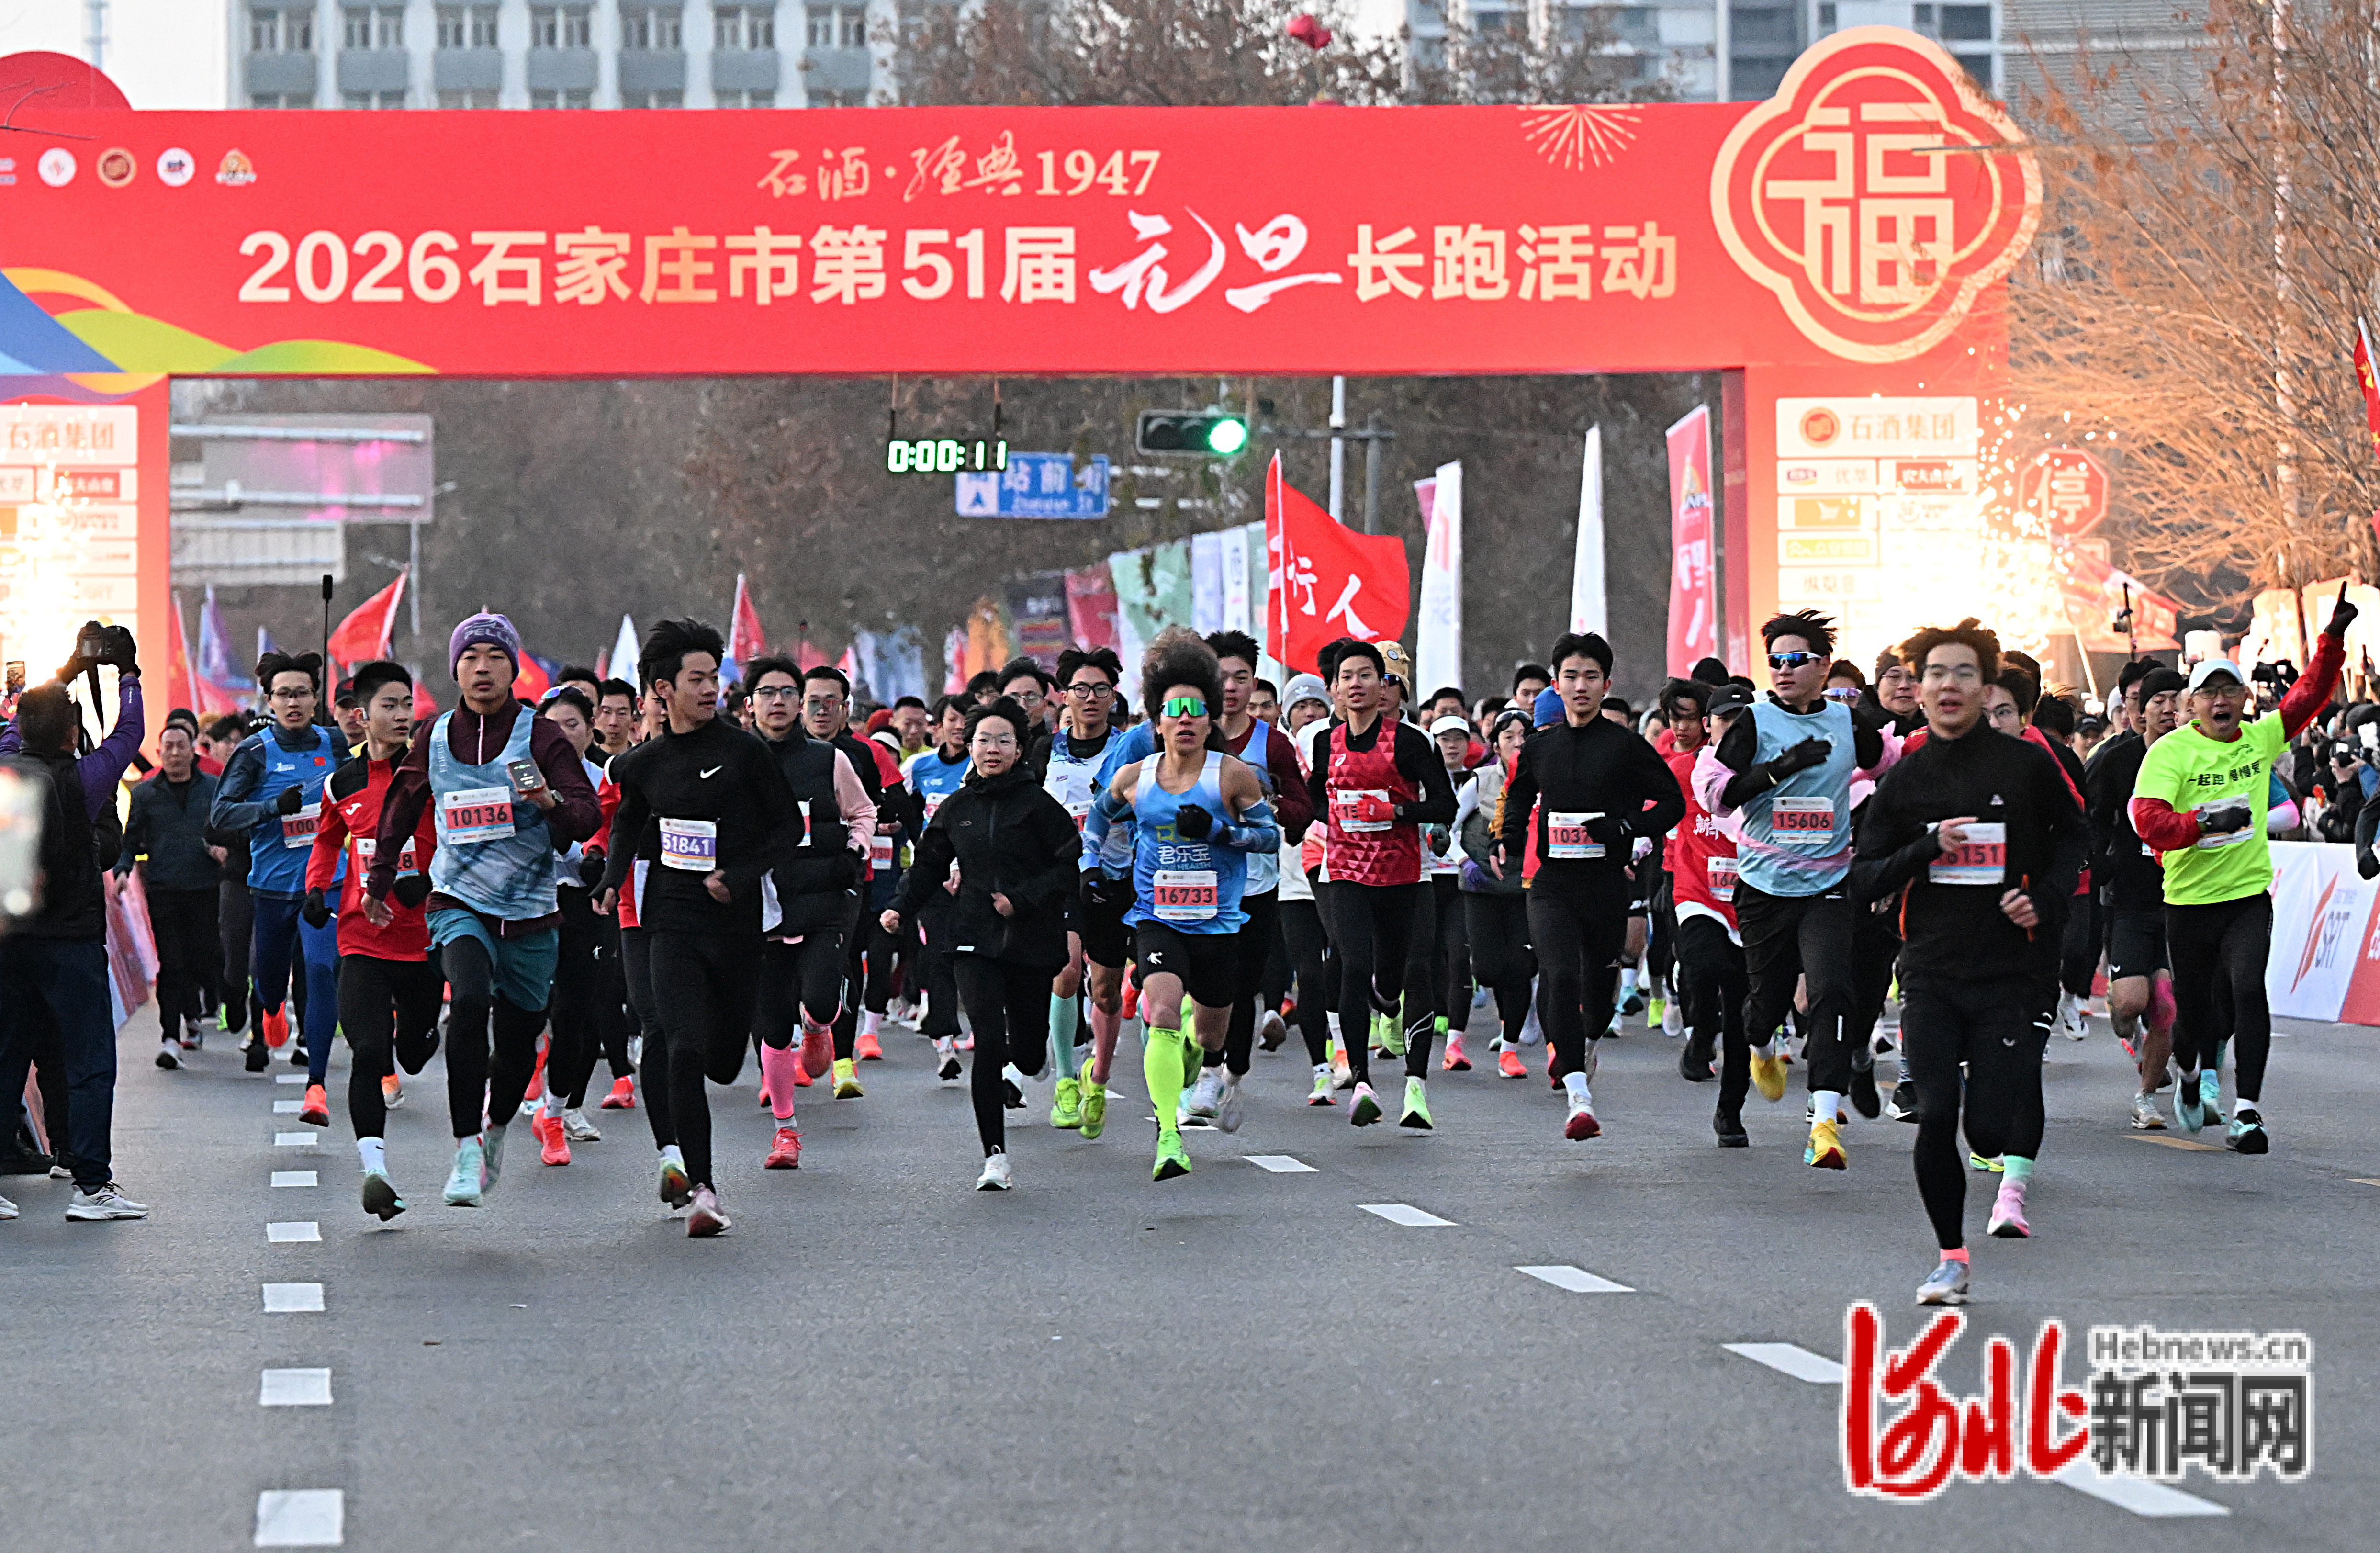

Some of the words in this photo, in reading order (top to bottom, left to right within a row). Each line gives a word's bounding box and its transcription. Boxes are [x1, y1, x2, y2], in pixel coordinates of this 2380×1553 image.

[1766, 102, 1954, 304] 福
[1848, 413, 1954, 440] 石酒集团
[888, 440, 1007, 472] 0:00:11
[2034, 464, 2091, 526] 停
[452, 805, 508, 827] 10136
[1778, 813, 1830, 828] 15606
[662, 833, 709, 855] 51841
[1158, 843, 1211, 865] 君乐宝
[1160, 888, 1212, 904] 16733
